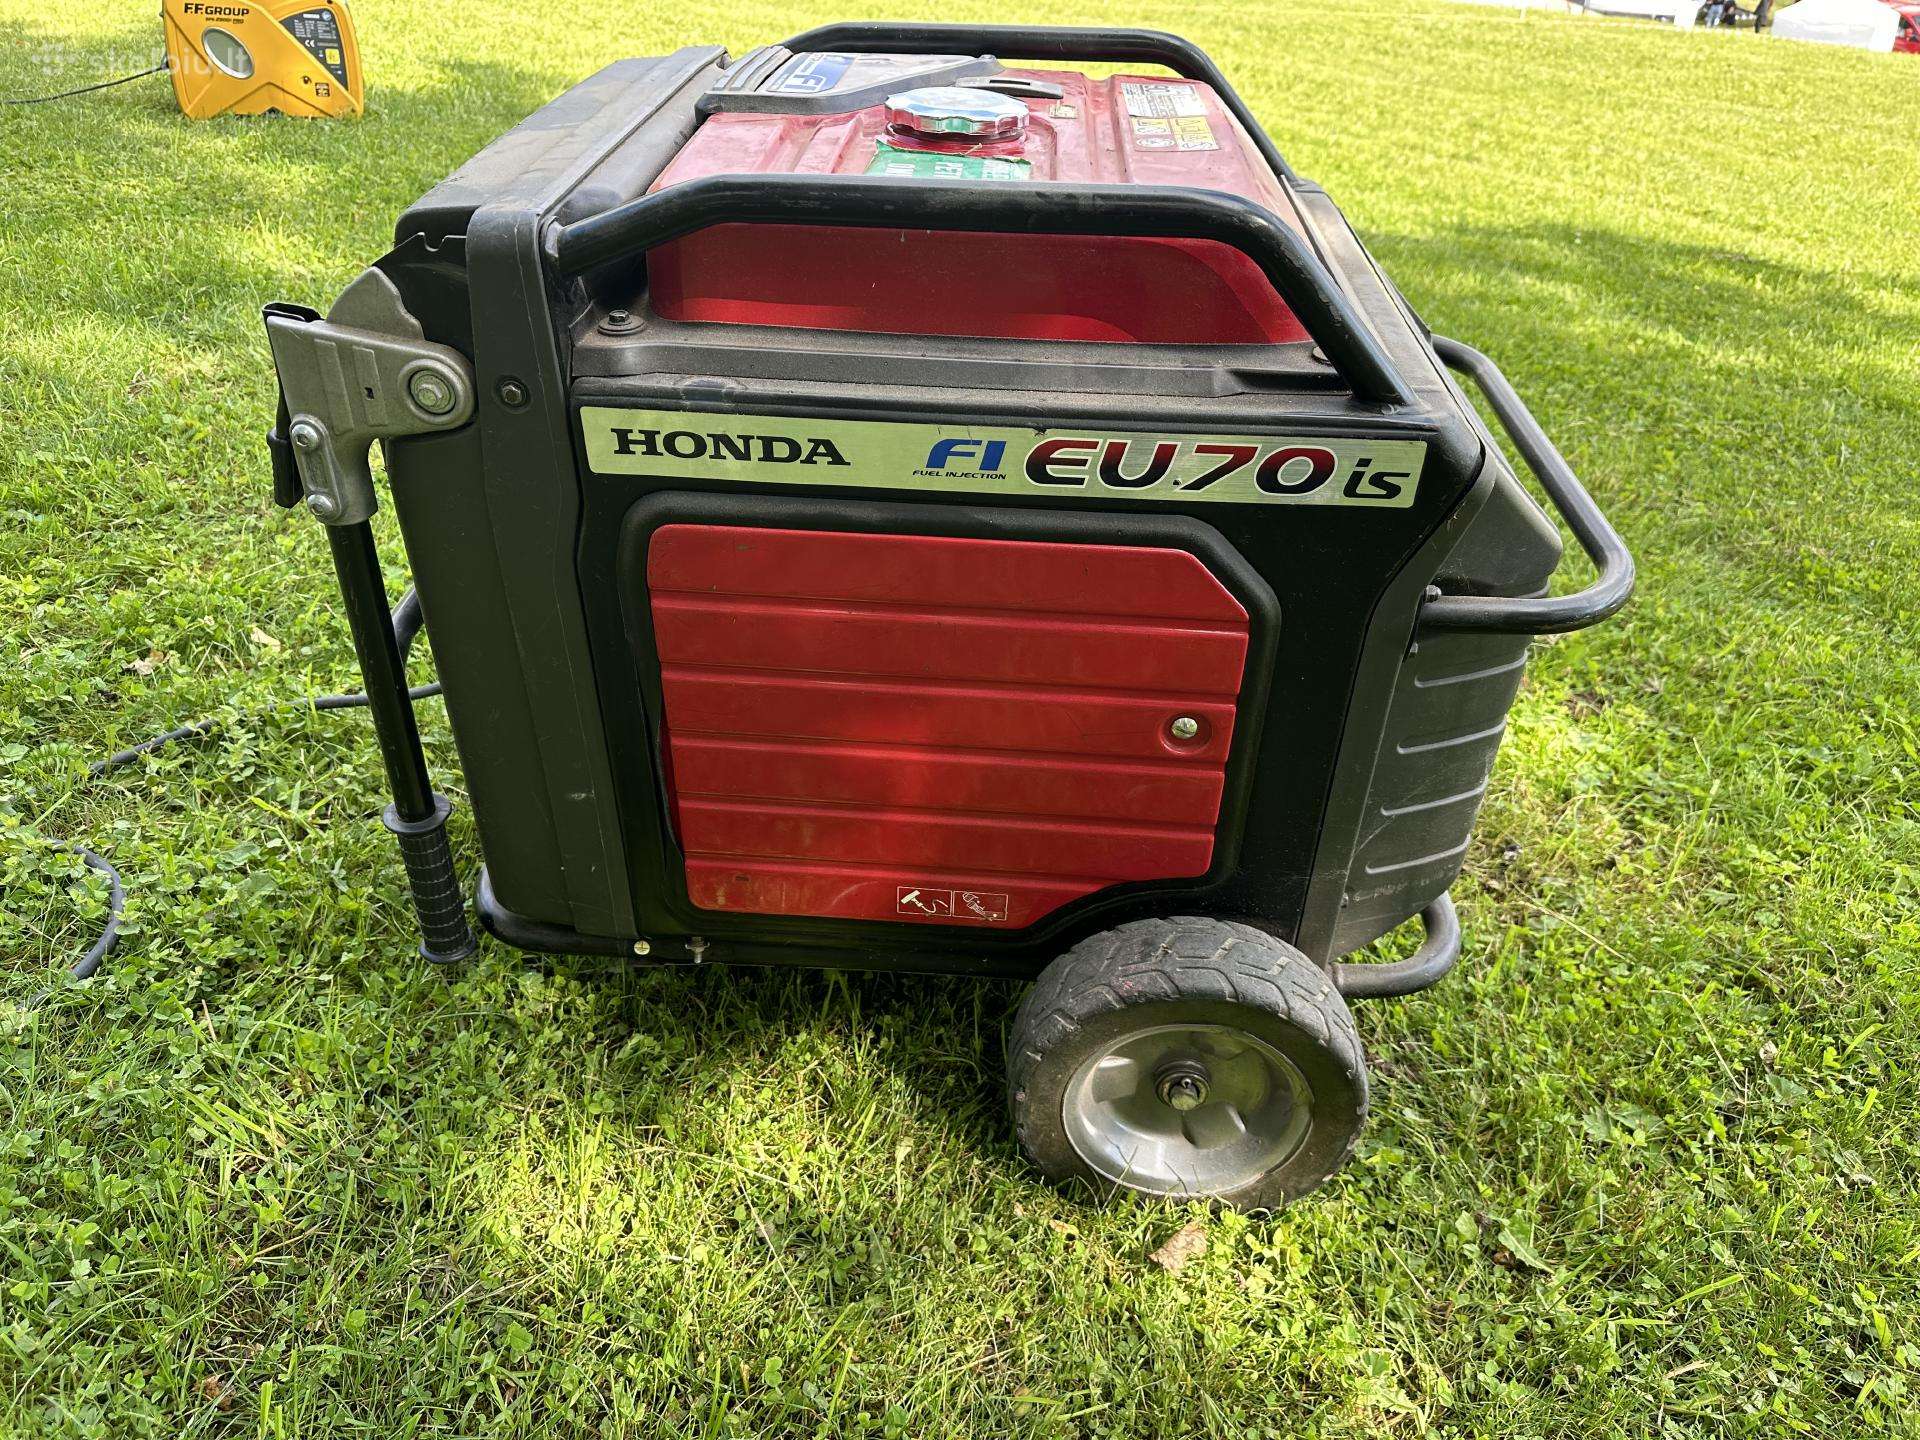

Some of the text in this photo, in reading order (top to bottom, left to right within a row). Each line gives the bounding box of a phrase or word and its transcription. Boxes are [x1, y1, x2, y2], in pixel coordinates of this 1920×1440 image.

[610, 428, 852, 466] HONDA
[925, 438, 1007, 471] FI
[945, 471, 1008, 480] INJECTION
